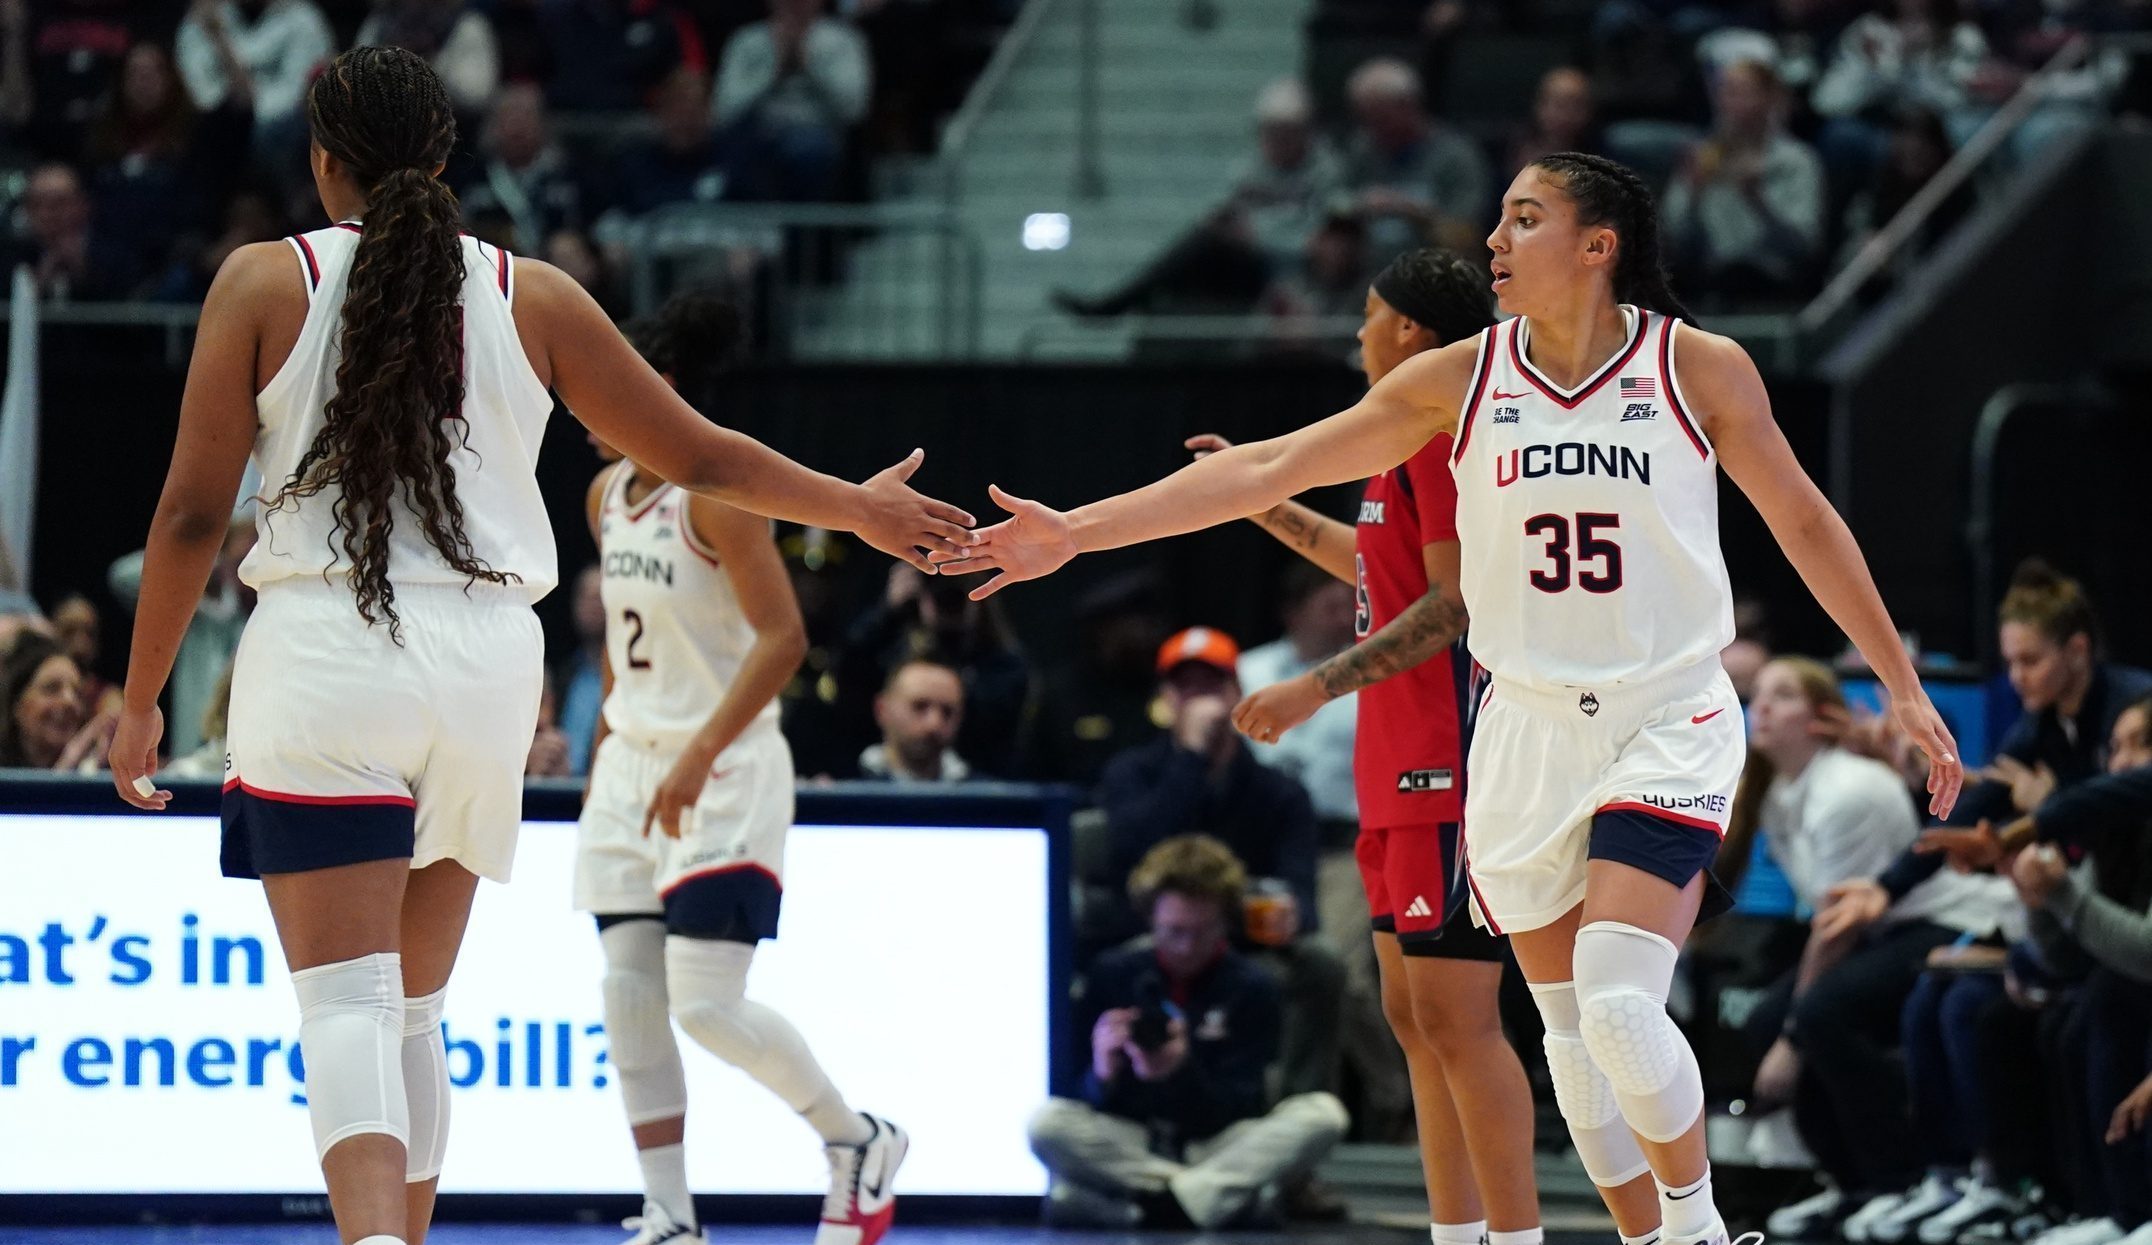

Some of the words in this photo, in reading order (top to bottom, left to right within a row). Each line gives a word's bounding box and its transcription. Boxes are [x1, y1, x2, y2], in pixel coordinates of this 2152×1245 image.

[1504, 407, 1520, 416] THE
[1622, 410, 1659, 418] EAST
[1626, 403, 1652, 411] BIG
[1497, 442, 1650, 487] UCONN
[1524, 512, 1623, 594] 35
[622, 605, 651, 671] 2
[1643, 794, 1726, 812] HUSKIES
[182, 913, 264, 984] in
